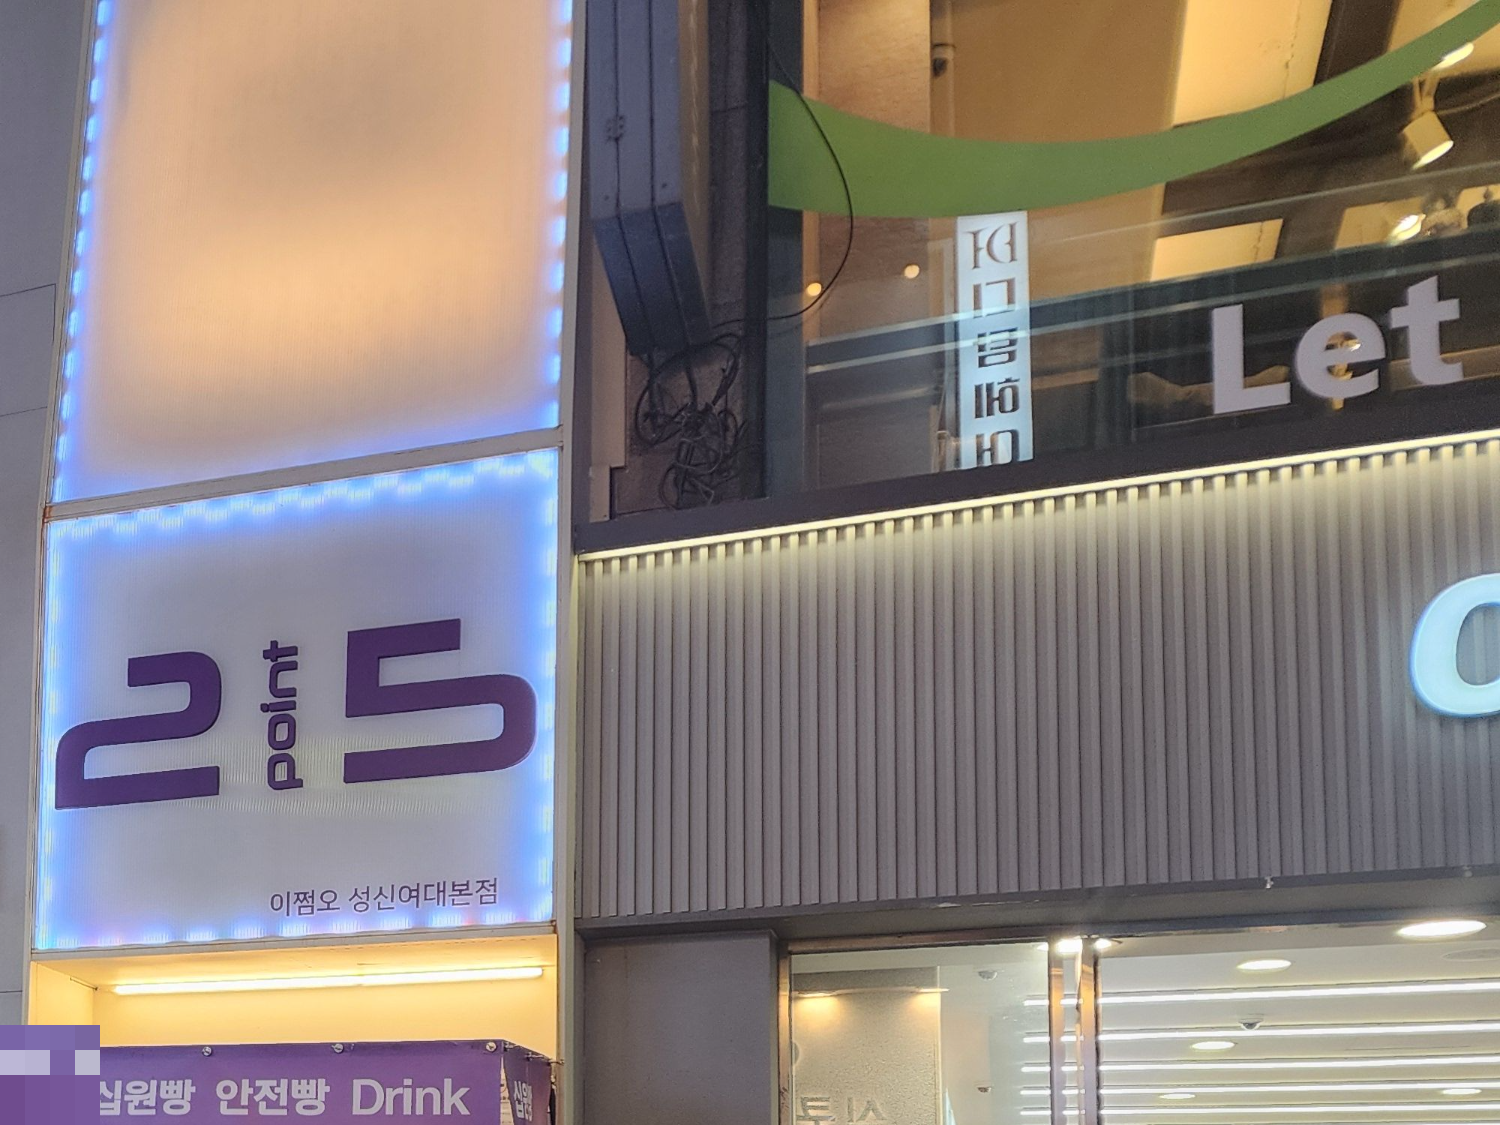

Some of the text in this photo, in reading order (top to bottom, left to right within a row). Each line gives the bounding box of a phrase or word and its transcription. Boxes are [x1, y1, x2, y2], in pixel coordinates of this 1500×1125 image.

[1211, 274, 1464, 415] Let
[54, 617, 538, 811] 2 point 5
[269, 876, 499, 918] 이쩜오 성신여대본점
[100, 1078, 471, 1117] 십원빵 안전빵 Drink
